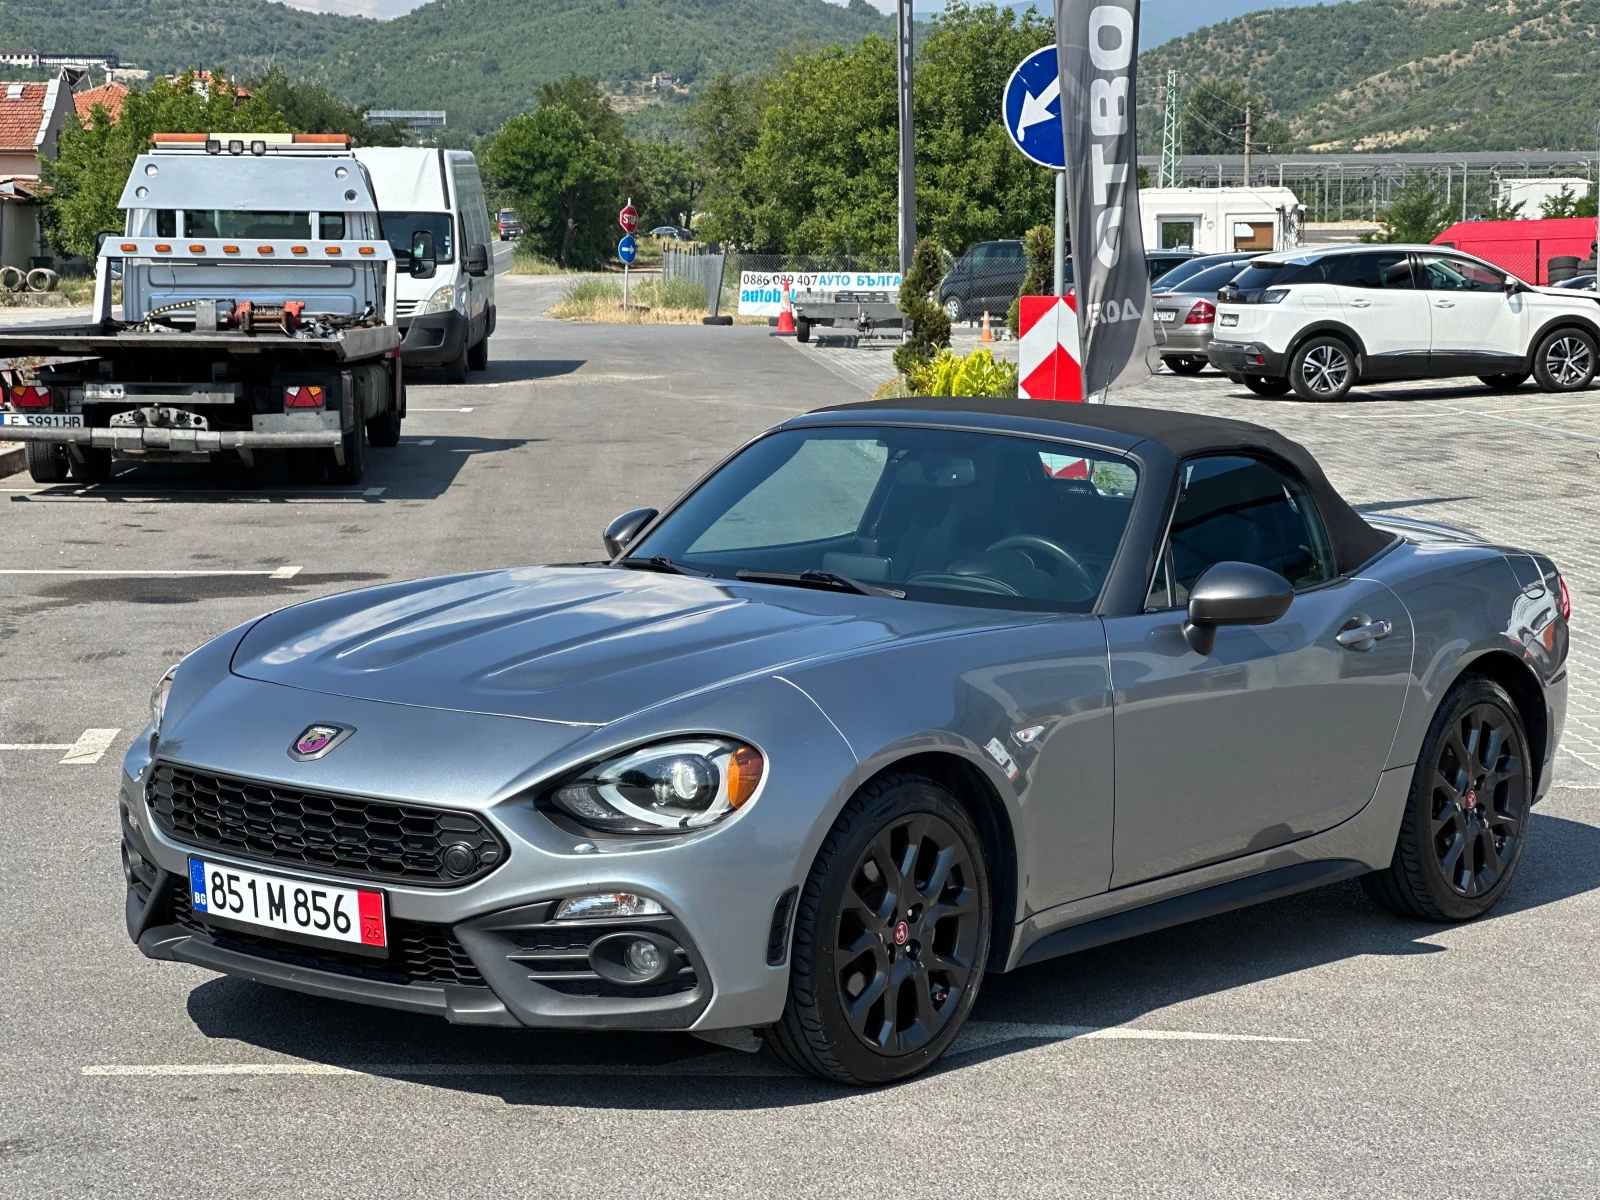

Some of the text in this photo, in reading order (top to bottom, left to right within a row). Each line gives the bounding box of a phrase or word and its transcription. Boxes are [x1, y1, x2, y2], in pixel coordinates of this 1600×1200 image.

[623, 213, 636, 225] STOP
[743, 274, 770, 286] 0886
[773, 274, 794, 286] 089
[797, 275, 818, 287] 407
[819, 275, 851, 287] АУТО
[194, 891, 207, 906] BG
[211, 871, 351, 934] 851 M 856
[365, 925, 381, 940] 26
